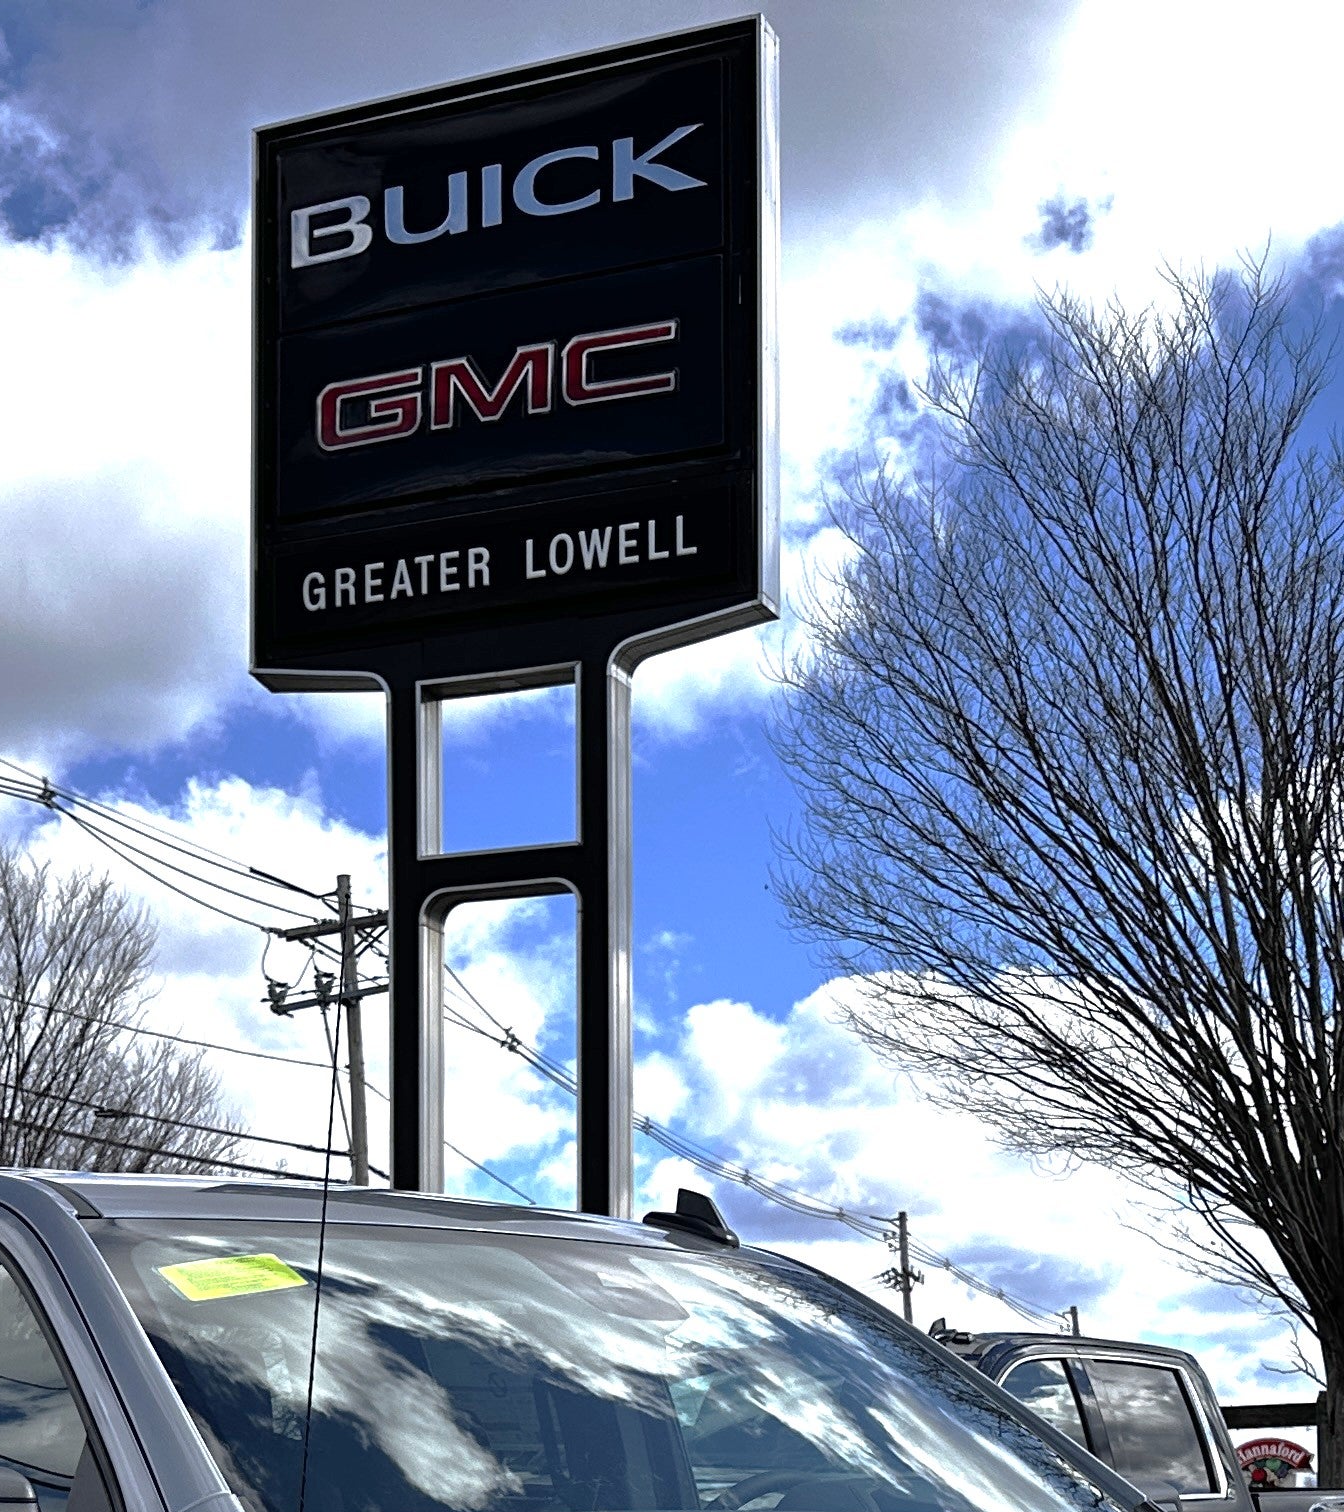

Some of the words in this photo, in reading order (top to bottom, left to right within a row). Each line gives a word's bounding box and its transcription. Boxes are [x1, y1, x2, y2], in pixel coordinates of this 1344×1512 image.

[290, 123, 708, 269] BUICK
[316, 318, 678, 452] GMC
[302, 546, 491, 612] GREATER
[525, 514, 698, 579] LOWELL
